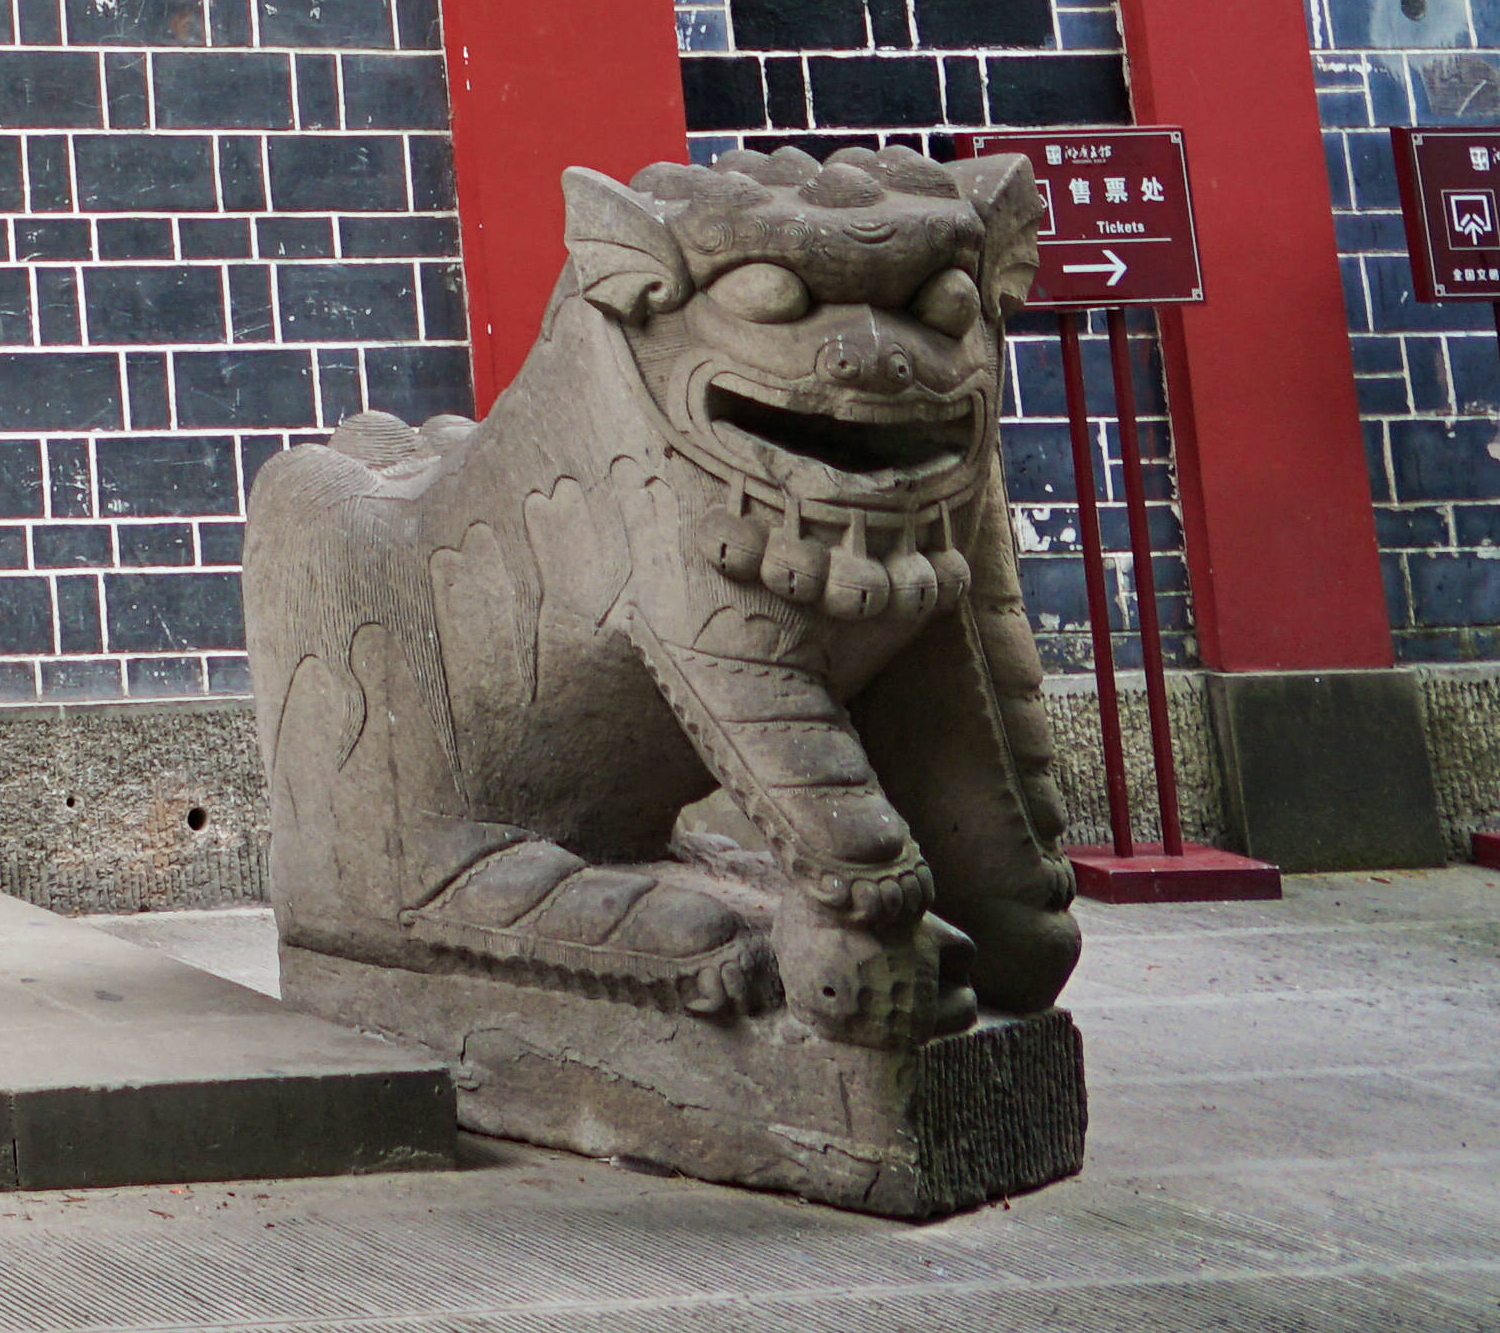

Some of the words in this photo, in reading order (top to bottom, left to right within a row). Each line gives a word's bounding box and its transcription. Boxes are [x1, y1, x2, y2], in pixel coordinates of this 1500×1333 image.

[1068, 176, 1165, 205] 售票处
[1096, 220, 1145, 234] Tickets
